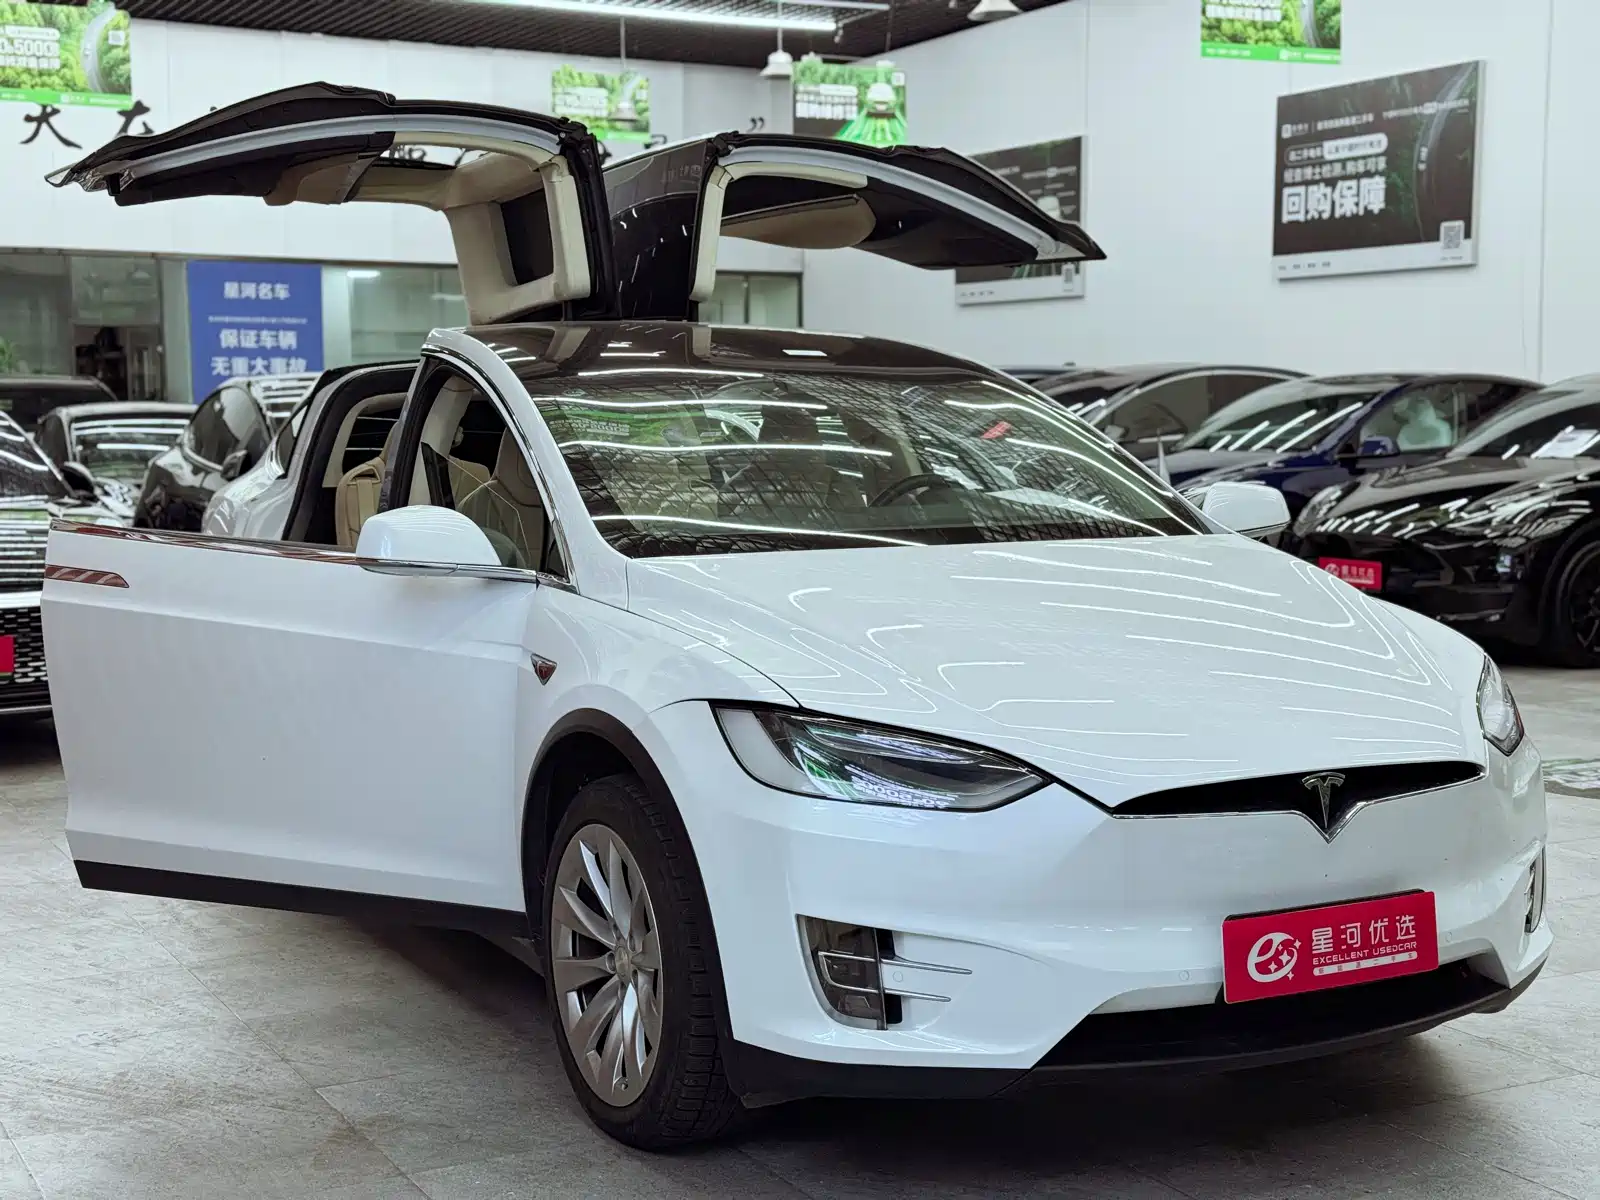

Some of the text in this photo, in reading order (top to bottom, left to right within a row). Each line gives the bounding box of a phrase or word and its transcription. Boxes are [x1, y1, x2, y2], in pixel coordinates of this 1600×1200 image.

[1281, 175, 1386, 224] 回购保障
[224, 281, 291, 300] 星河名车
[220, 328, 298, 350] 保证车辆
[1312, 914, 1417, 955] 星河优选
[1312, 941, 1417, 965] EXCELLENT USEDCAR
